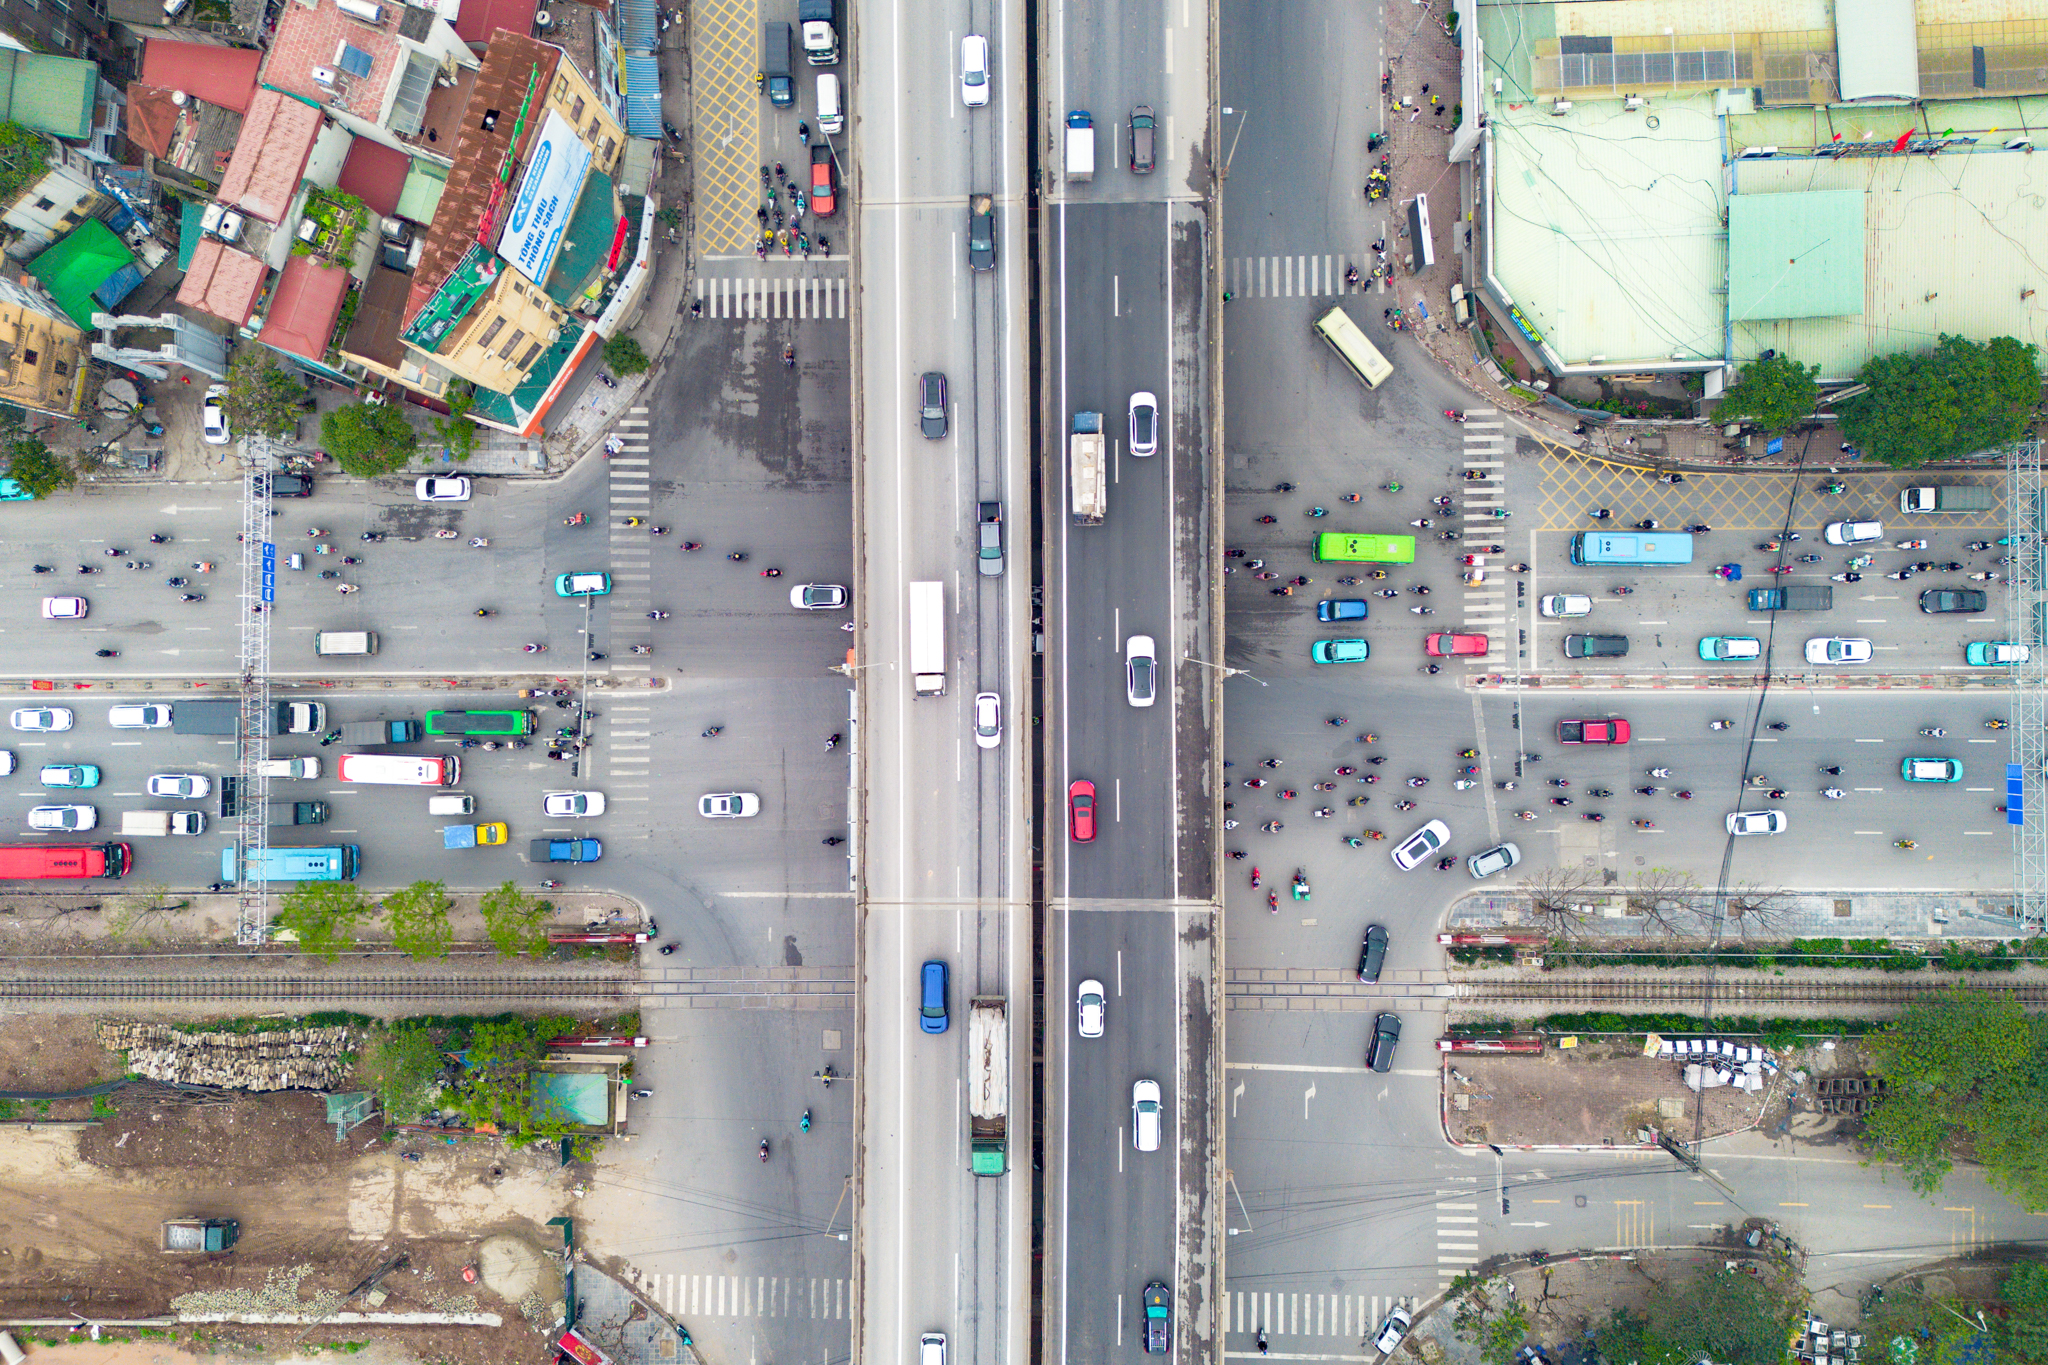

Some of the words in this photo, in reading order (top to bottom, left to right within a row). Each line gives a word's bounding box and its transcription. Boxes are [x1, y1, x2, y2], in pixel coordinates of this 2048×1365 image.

[524, 181, 533, 197] ANH
[532, 145, 546, 176] KHANG
[529, 150, 550, 200] CLEANROOM
[526, 230, 545, 270] PHÒNG
[542, 196, 559, 228] SẠCH
